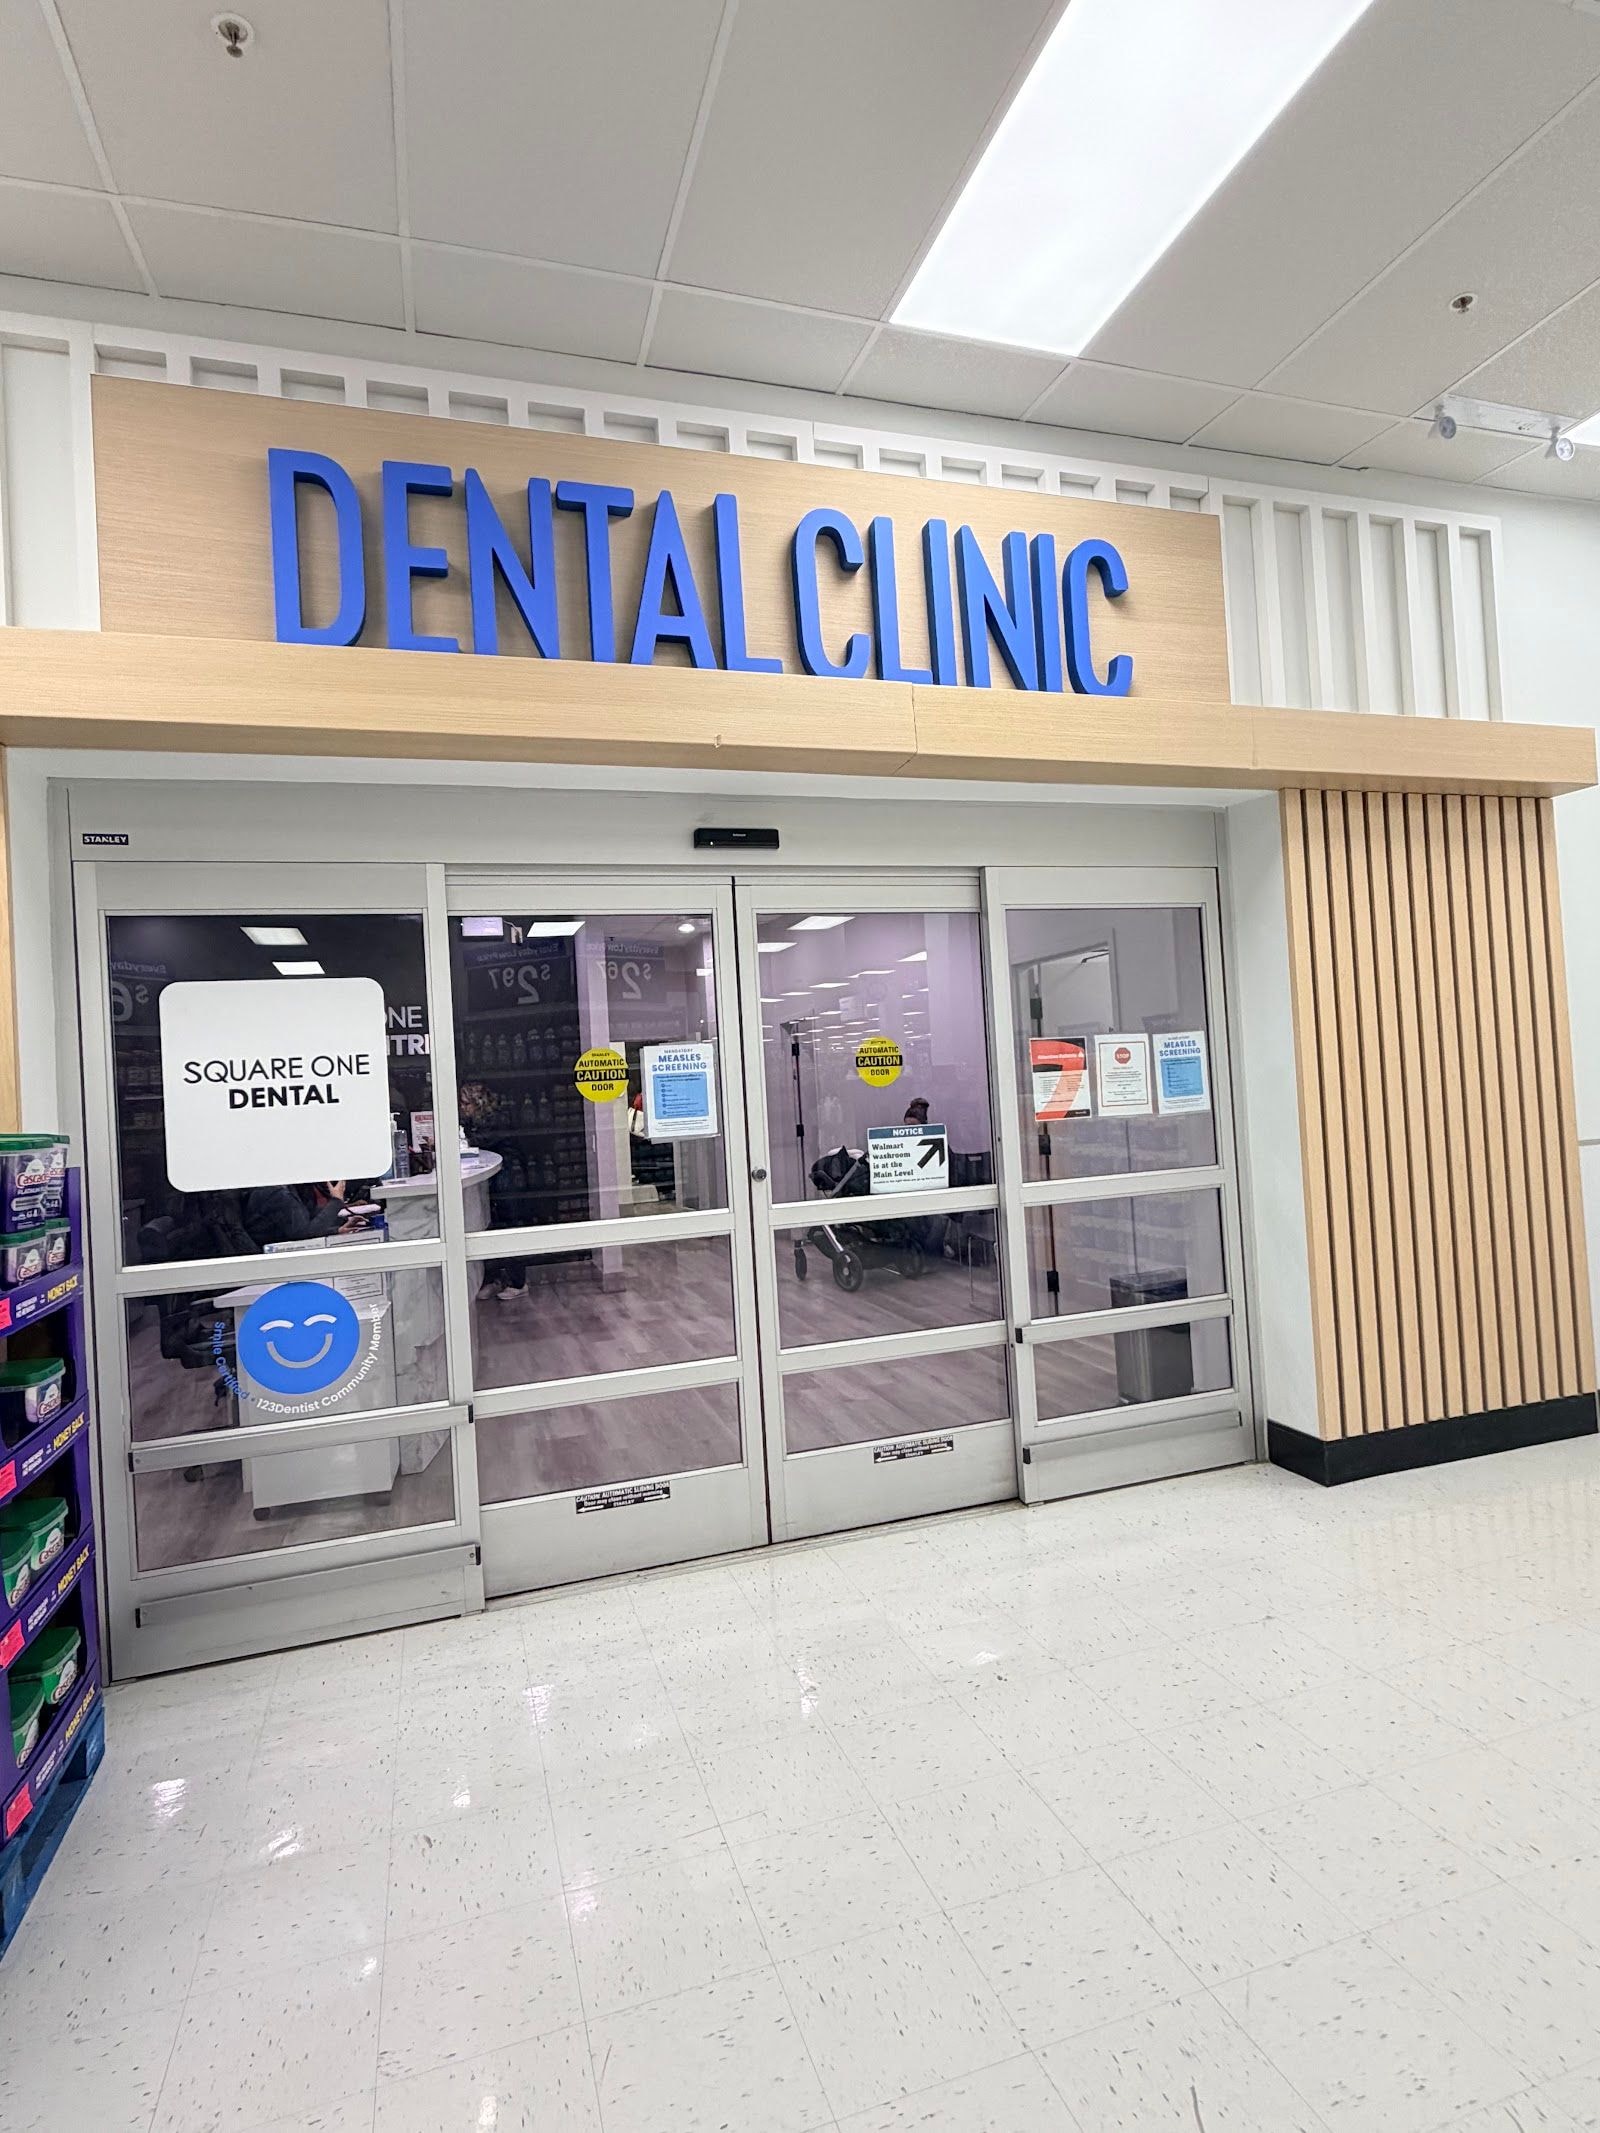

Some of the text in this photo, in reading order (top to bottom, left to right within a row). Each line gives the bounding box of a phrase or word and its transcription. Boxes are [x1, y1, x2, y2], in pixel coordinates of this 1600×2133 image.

[267, 447, 1133, 697] DENTAL CLINIC
[84, 835, 127, 843] STANLEY
[384, 1005, 423, 1029] NE
[1163, 1040, 1197, 1048] MEASLES
[859, 1046, 899, 1054] AUTOMATIC
[1159, 1047, 1201, 1057] SCREENING
[578, 1058, 625, 1068] AUTOMATIC
[658, 1053, 702, 1063] MEASLES
[857, 1055, 900, 1067] CAUTION
[183, 1054, 370, 1084] SQUARE ONE
[651, 1062, 708, 1072] SCREENING
[576, 1069, 626, 1081] CAUTION
[591, 1083, 614, 1091] DOOR
[229, 1083, 340, 1109] DENTAL
[892, 1127, 924, 1137] NOTICE
[872, 1152, 911, 1160] washroom
[873, 1169, 914, 1179] Main Level
[256, 1398, 320, 1414] 123Dentist
[321, 1352, 379, 1407] Community
[369, 1303, 382, 1351] Member
